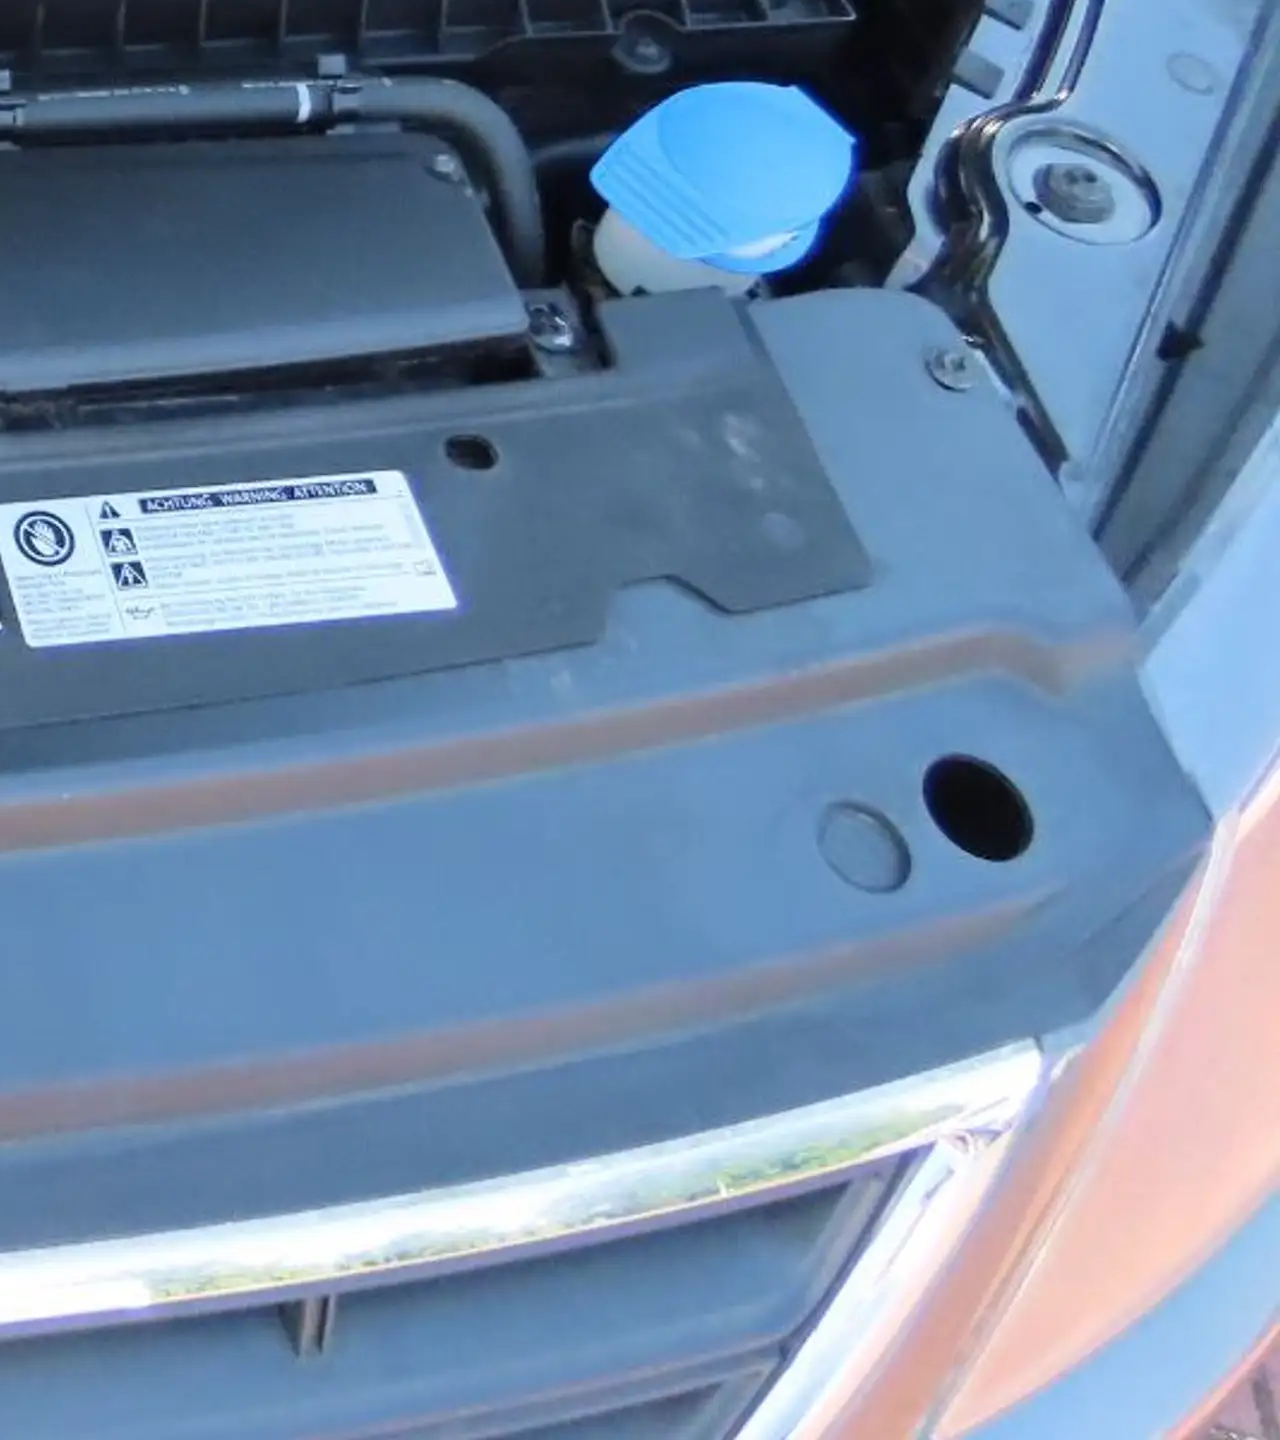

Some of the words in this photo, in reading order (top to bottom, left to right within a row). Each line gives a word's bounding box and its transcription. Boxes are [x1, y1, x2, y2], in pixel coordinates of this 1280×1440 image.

[145, 494, 213, 513] ACHTUNG
[221, 489, 288, 507] WARNING
[293, 481, 368, 500] ATTENTION
